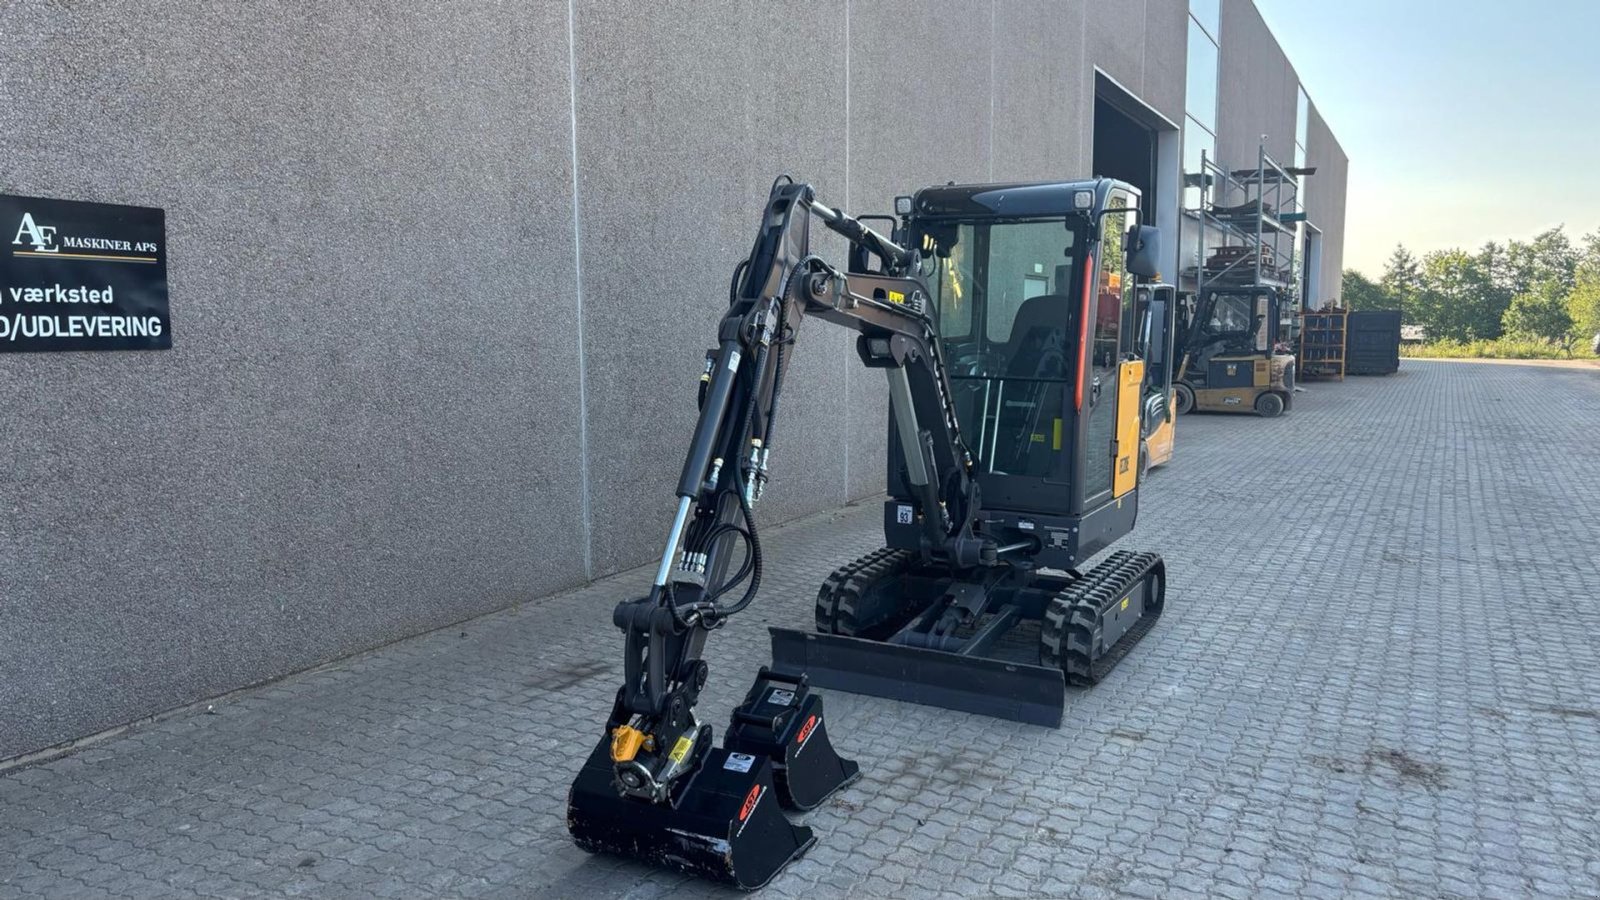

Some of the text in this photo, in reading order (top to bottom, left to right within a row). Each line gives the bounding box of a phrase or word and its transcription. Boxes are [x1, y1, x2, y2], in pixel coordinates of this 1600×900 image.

[63, 236, 131, 251] MASKINER
[134, 242, 157, 252] APS
[9, 284, 114, 303] værksted
